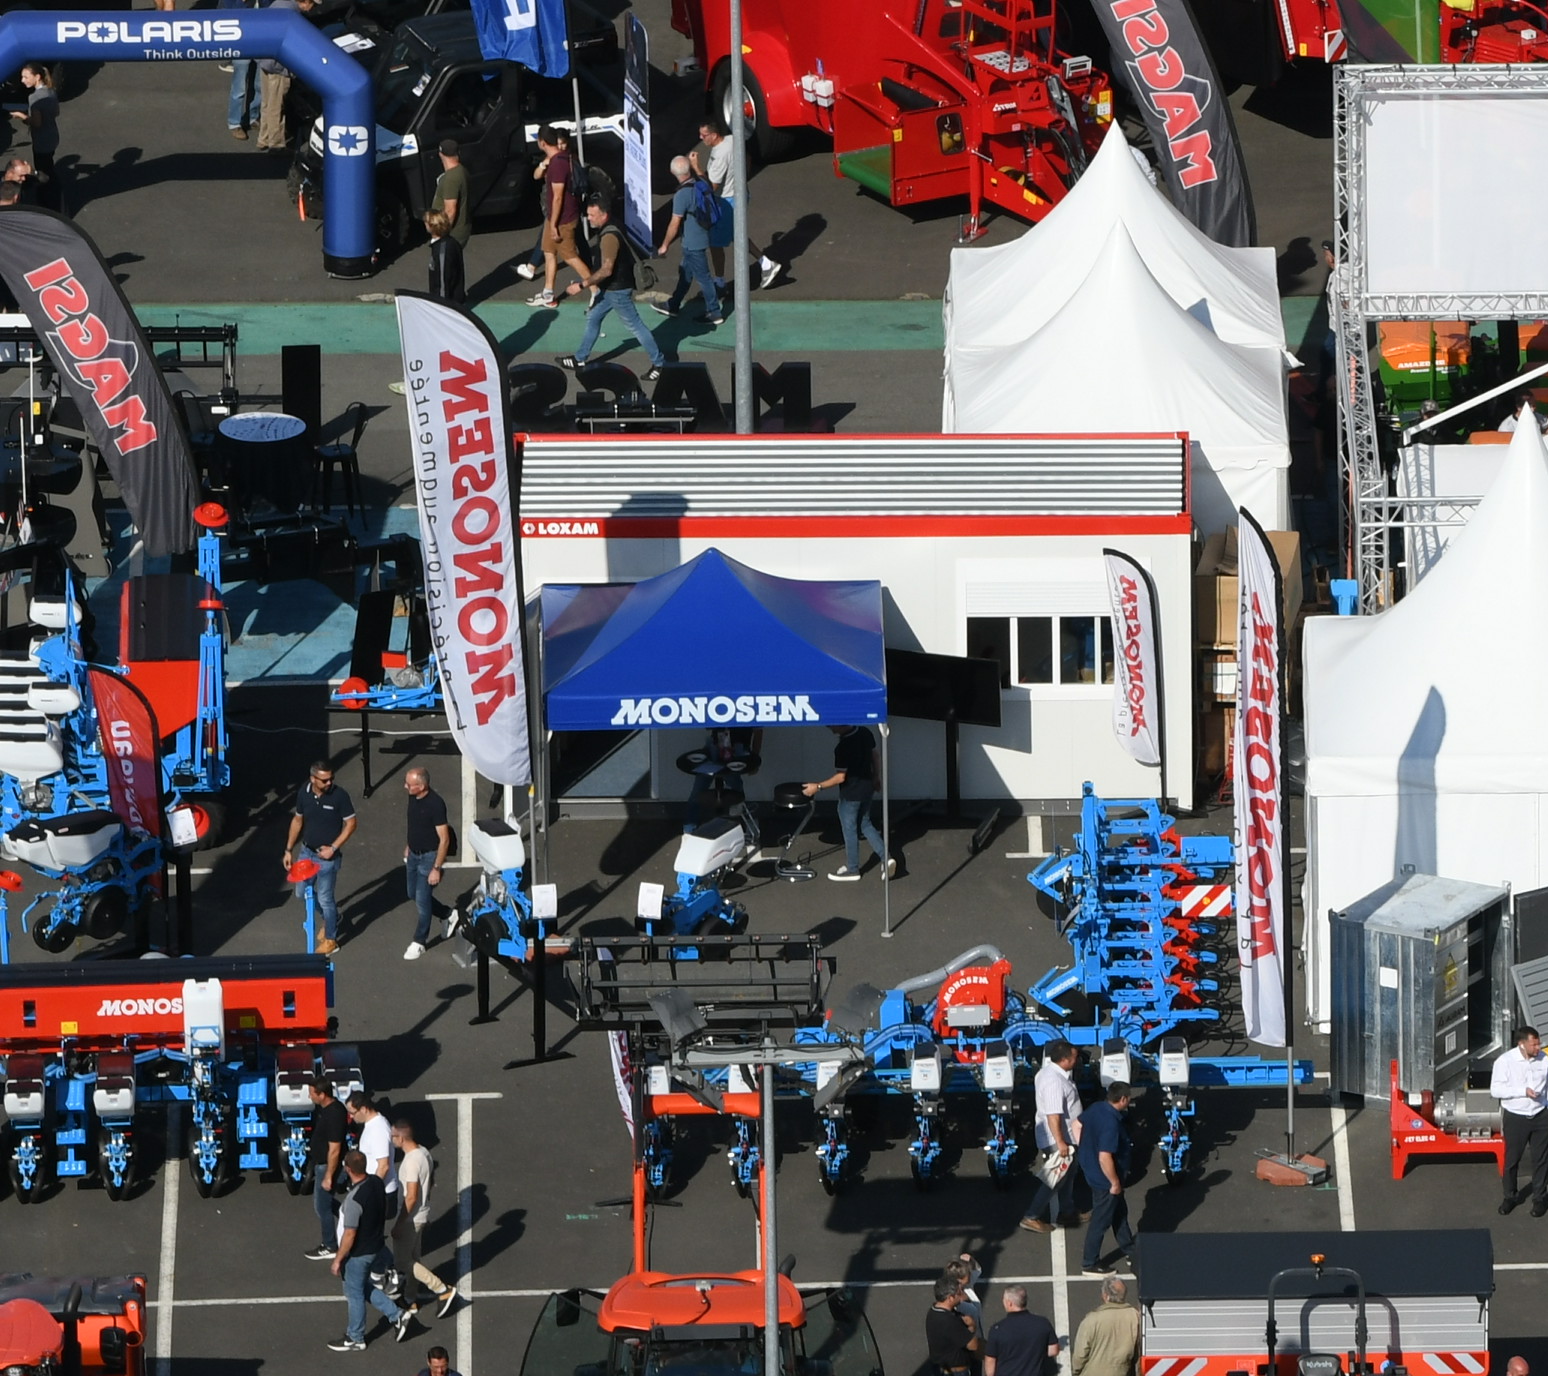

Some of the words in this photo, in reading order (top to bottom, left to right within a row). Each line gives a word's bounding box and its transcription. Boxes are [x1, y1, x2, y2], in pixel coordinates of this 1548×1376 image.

[56, 19, 243, 44] POLARIS
[144, 49, 182, 60] Think
[186, 49, 241, 60] Outside
[539, 522, 599, 536] LOXAM
[611, 696, 819, 725] MONOSEM
[943, 976, 988, 1003] MONOSEM
[97, 998, 184, 1016] MONOS
